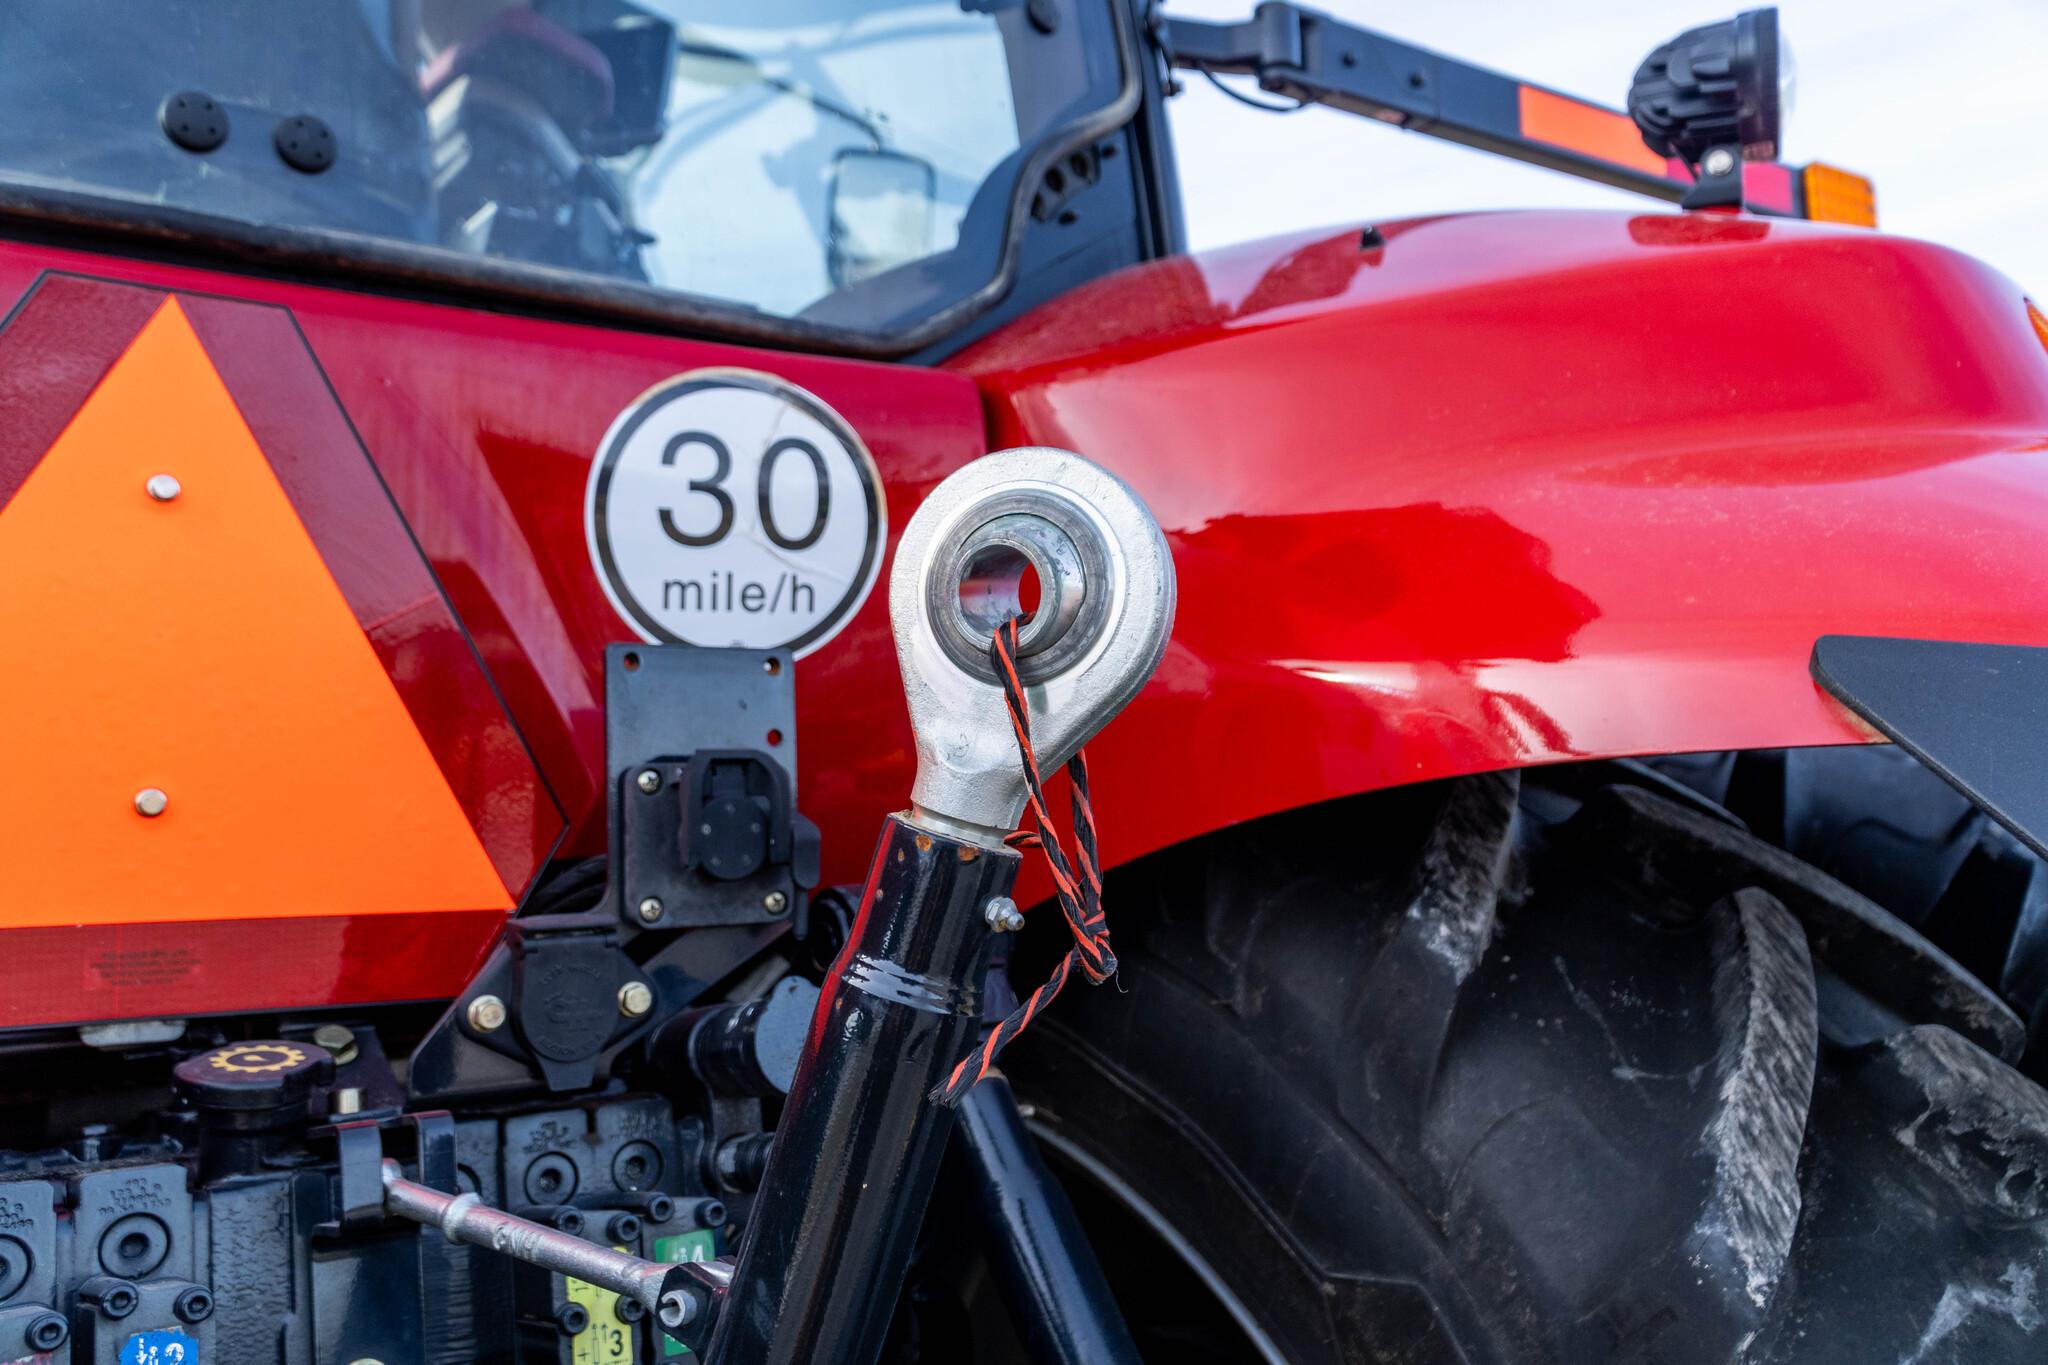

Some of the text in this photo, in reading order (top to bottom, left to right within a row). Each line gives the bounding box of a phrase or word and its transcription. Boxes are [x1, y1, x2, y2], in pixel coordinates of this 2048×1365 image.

[658, 431, 831, 551] 30
[663, 572, 815, 613] mile/h
[610, 1329, 624, 1357] 3
